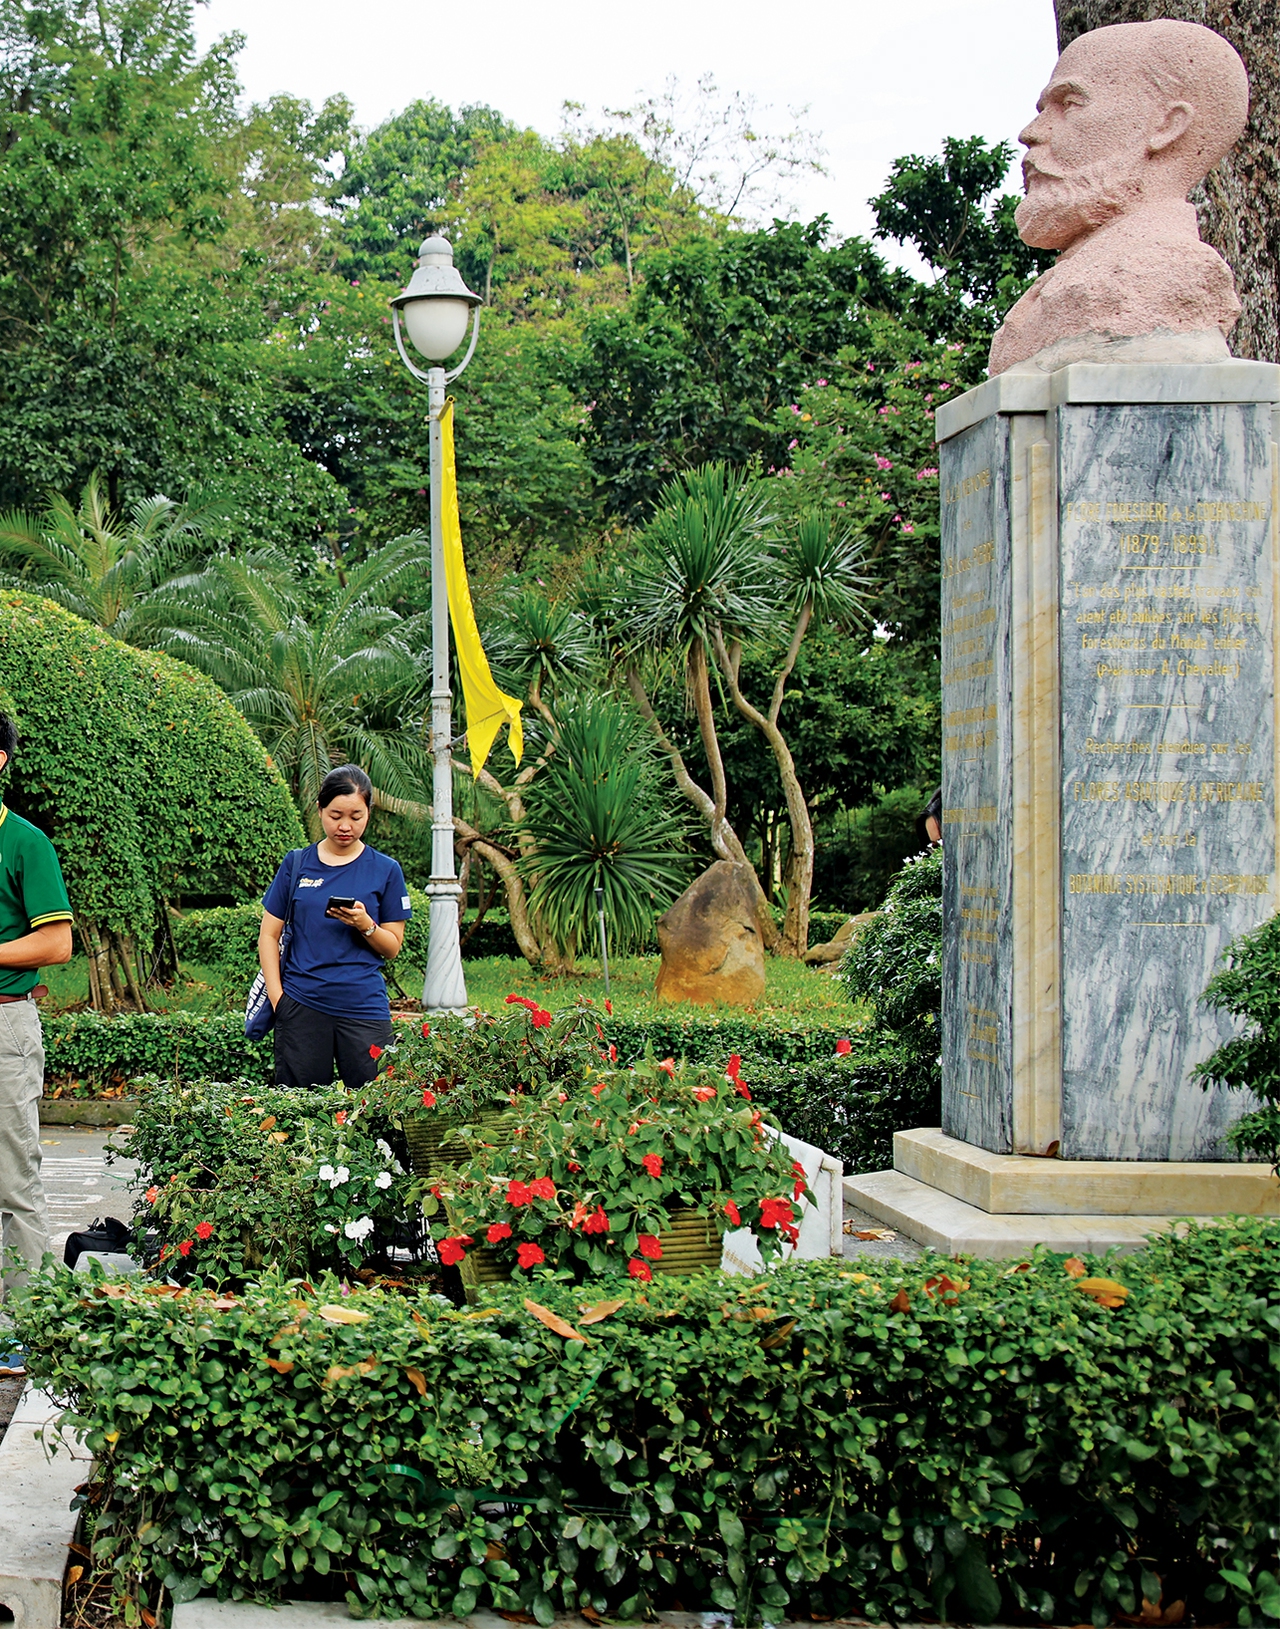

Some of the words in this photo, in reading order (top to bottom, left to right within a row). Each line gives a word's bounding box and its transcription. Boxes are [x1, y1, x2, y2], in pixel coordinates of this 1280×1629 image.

[1067, 502, 1101, 522] FLORE
[1185, 505, 1195, 521] la
[1197, 502, 1267, 521] COCHINCHINE
[1100, 582, 1120, 598] des
[1124, 582, 1148, 603] plus
[1153, 583, 1191, 598] vastes
[1195, 583, 1239, 598] travaux
[1201, 608, 1219, 624] les
[1151, 633, 1166, 649] du
[1171, 634, 1208, 649] Monde
[1085, 737, 1152, 754] Recherches
[1211, 743, 1229, 754] sur
[1235, 738, 1251, 754] les
[1074, 781, 1120, 802] FLORES
[1124, 781, 1186, 803] ASIATIQUE
[1200, 781, 1265, 802] AFRICAINE
[1141, 829, 1153, 846] et
[1159, 835, 1179, 846] sur
[1185, 830, 1197, 847] la
[1069, 874, 1122, 895] BOTANIQUE
